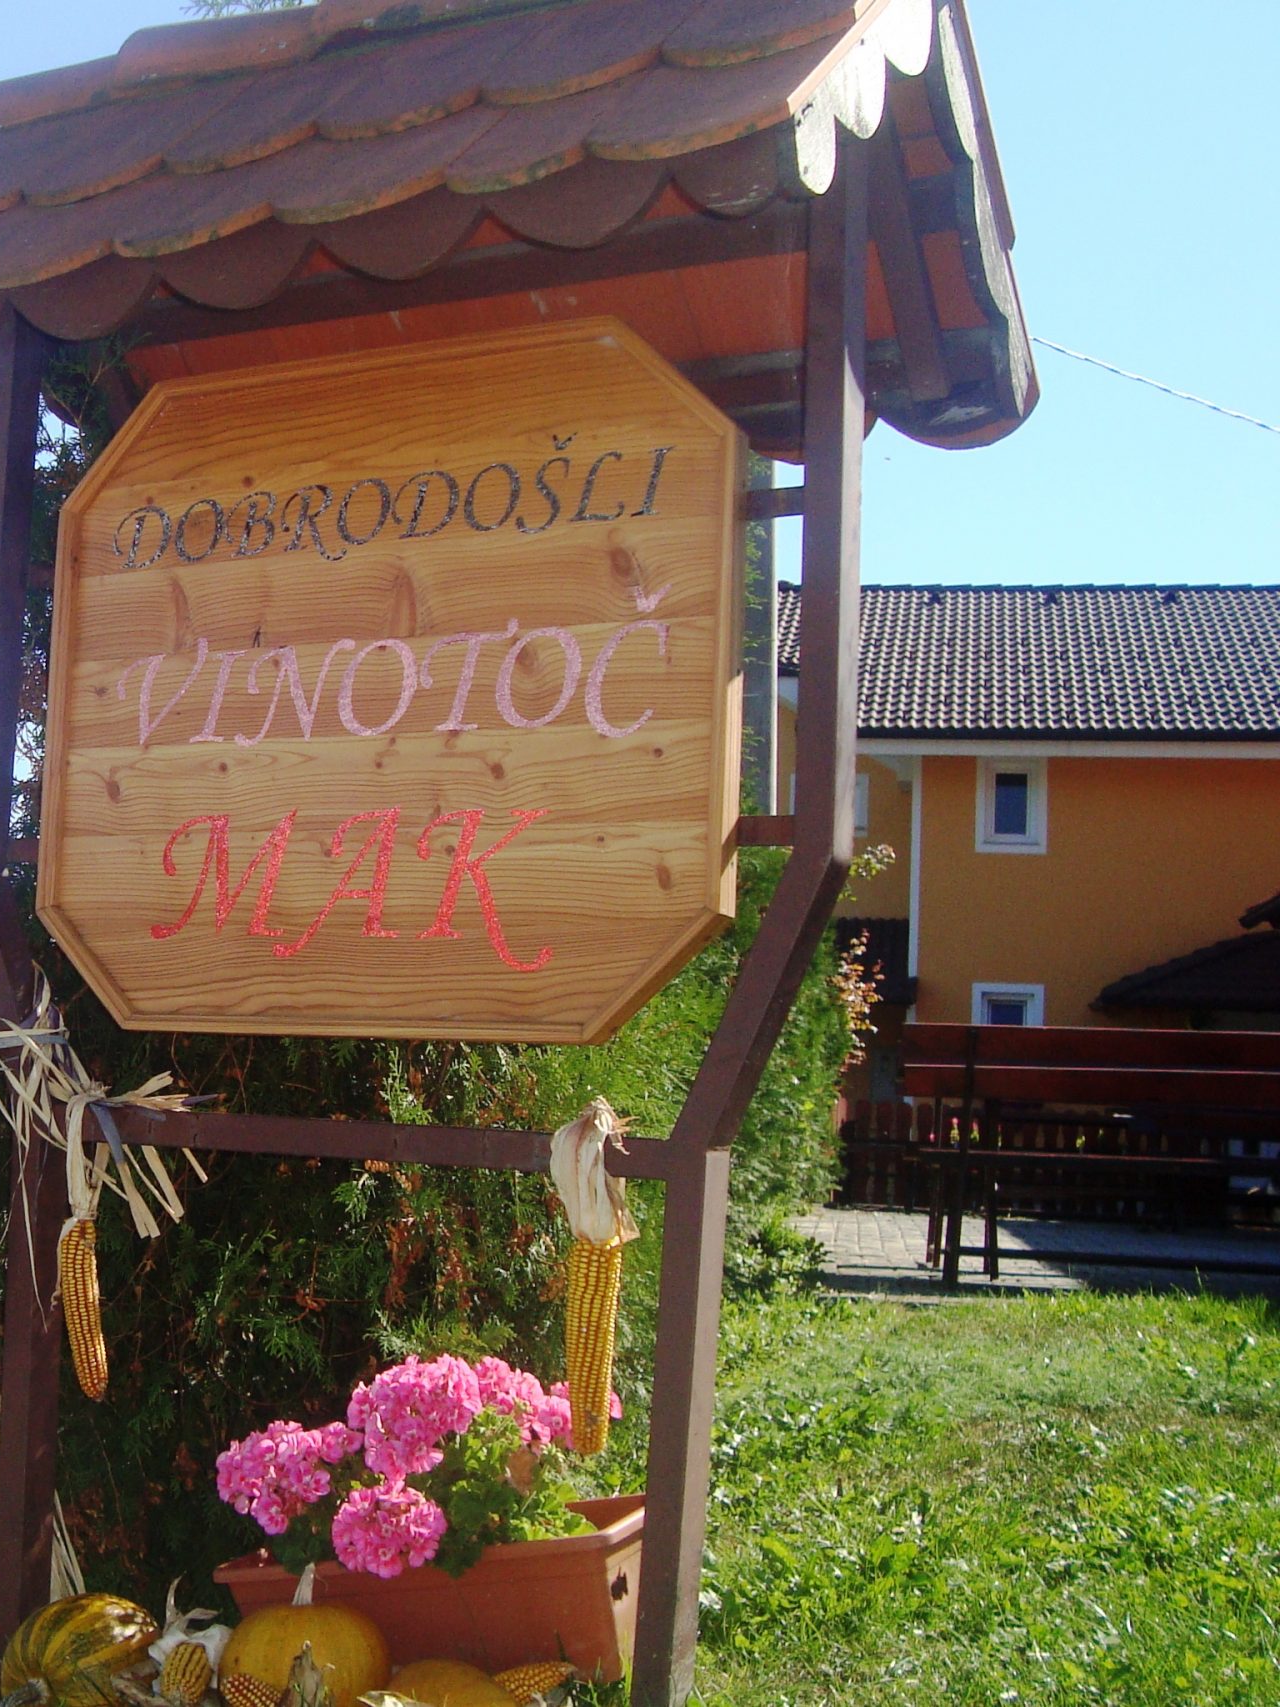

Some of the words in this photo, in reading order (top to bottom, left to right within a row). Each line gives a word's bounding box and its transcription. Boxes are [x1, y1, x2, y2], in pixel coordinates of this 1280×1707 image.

[114, 432, 675, 569] DOBRODOŠLI
[117, 583, 672, 746] VINOTOČ
[150, 805, 553, 972] MAK
